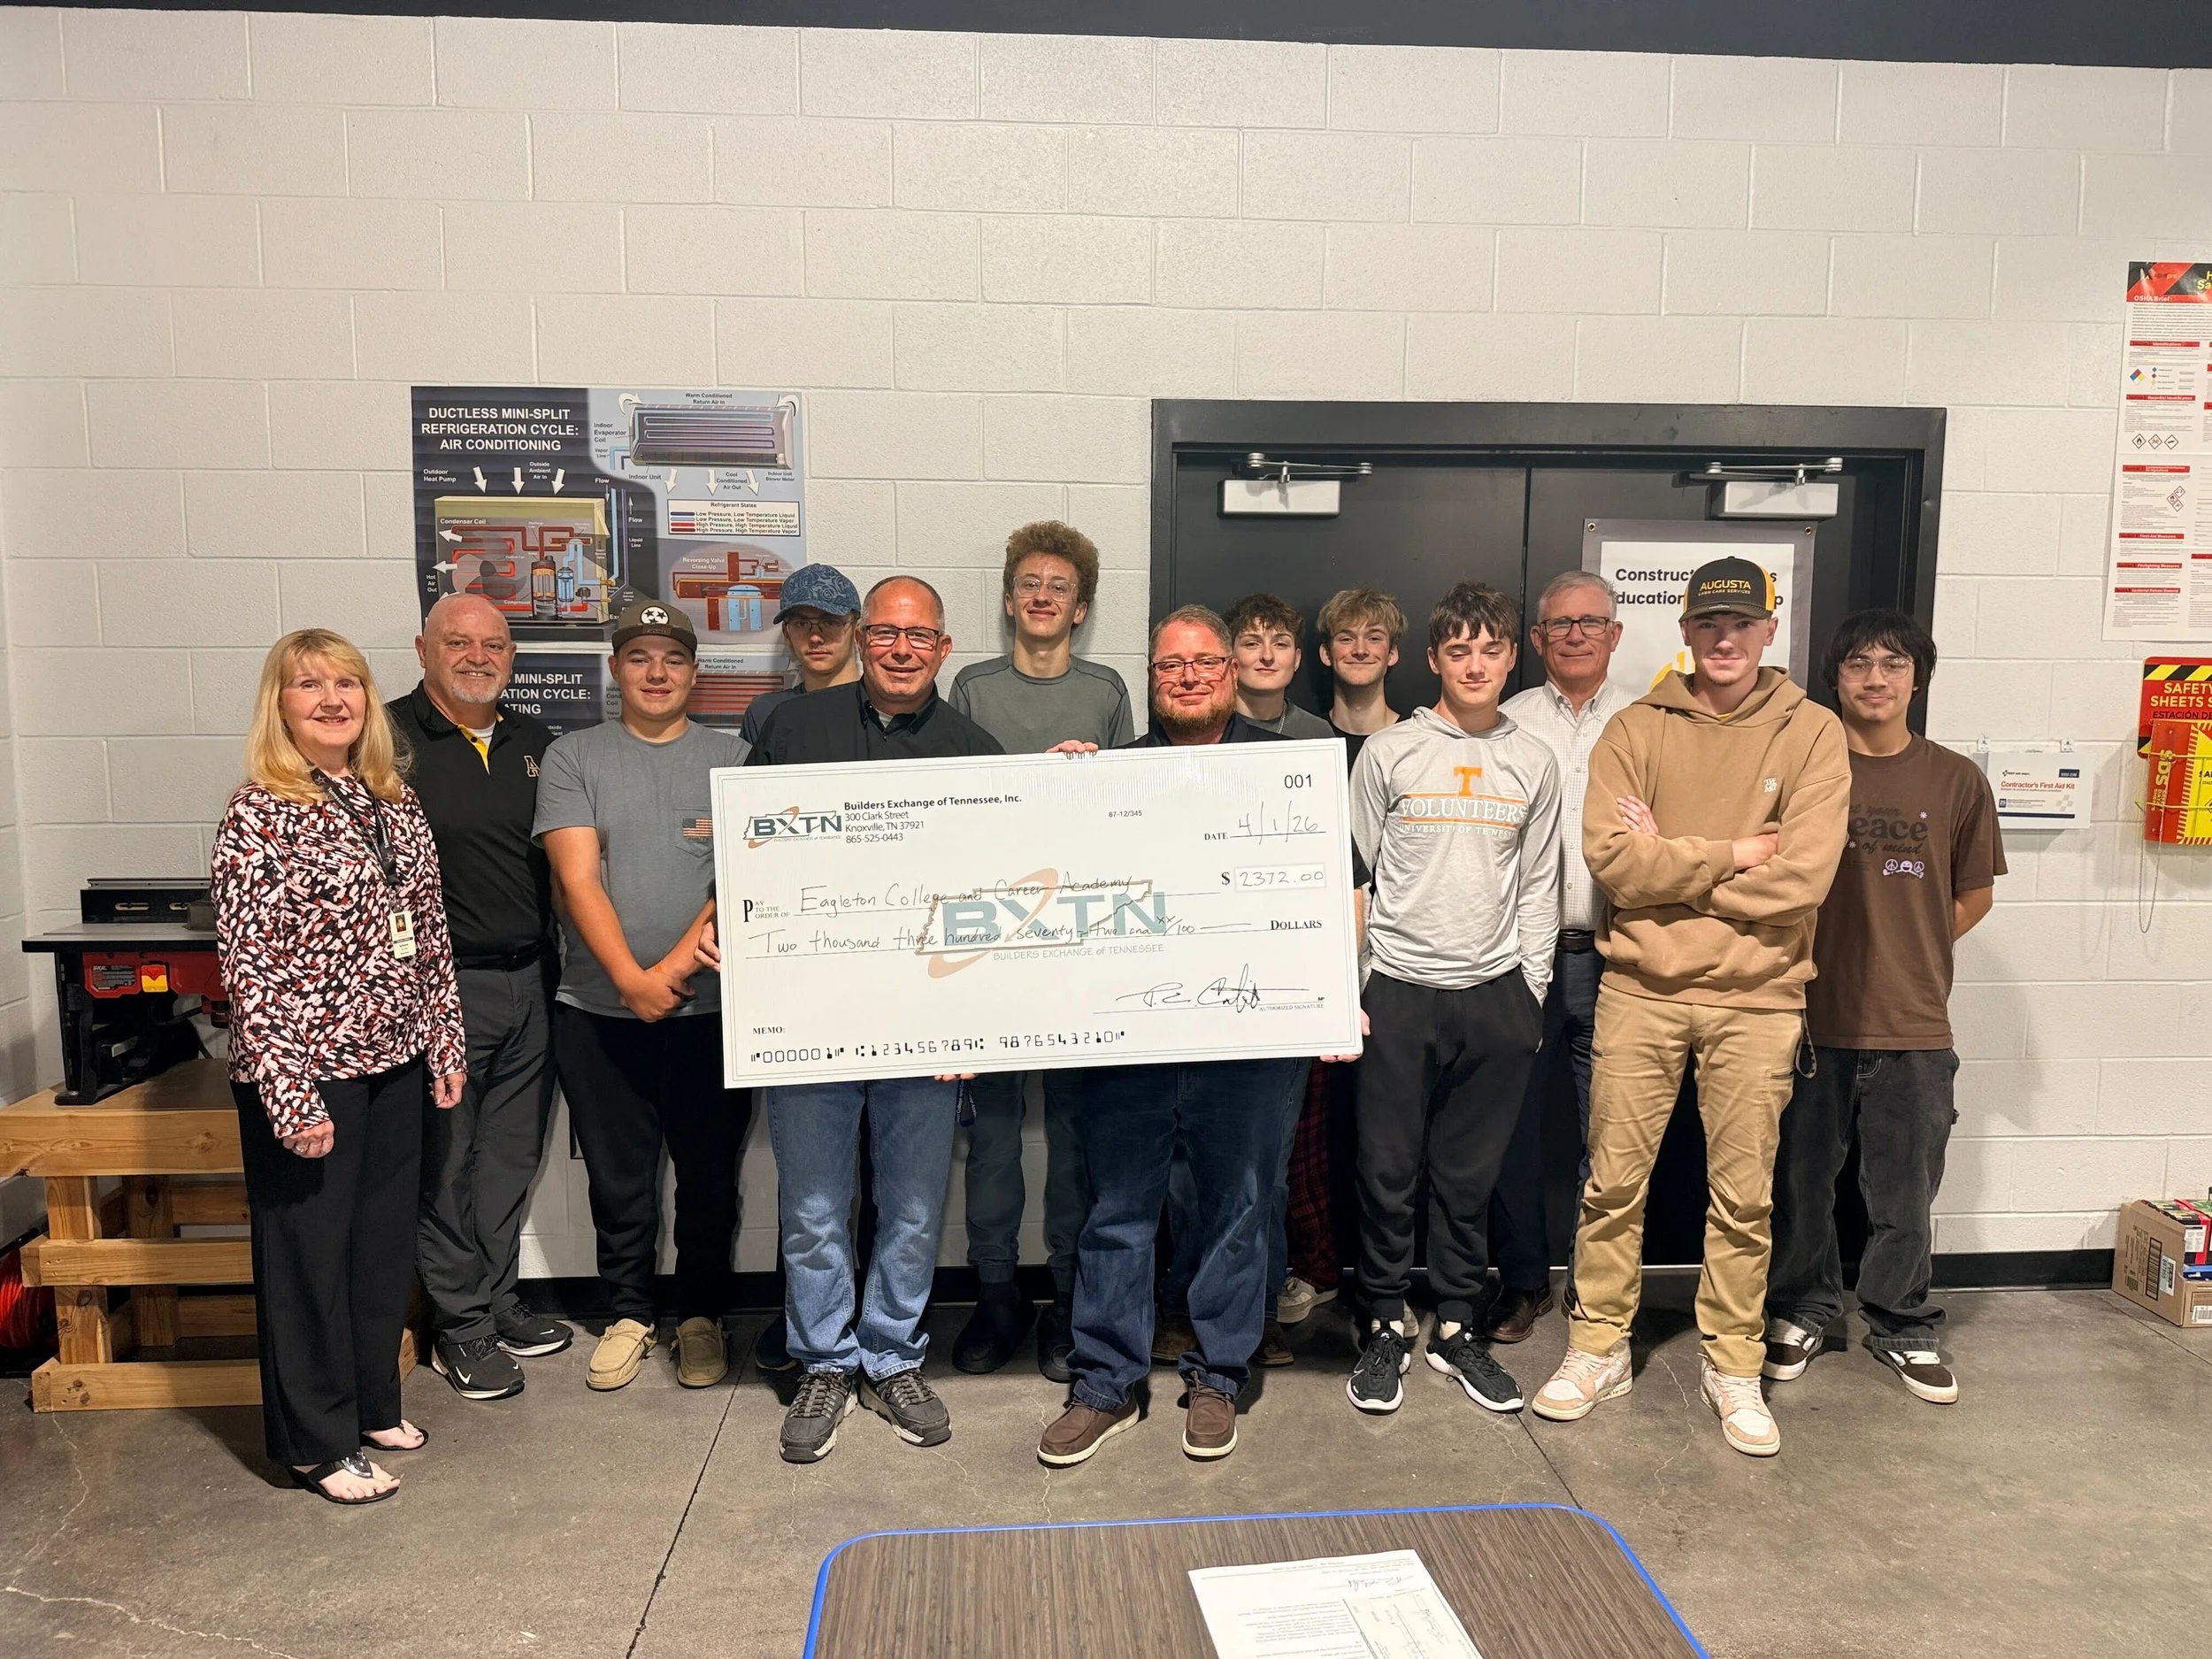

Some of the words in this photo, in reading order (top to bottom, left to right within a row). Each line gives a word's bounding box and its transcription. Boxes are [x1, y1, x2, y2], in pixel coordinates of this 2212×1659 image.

[429, 408, 498, 419] DUCTLESS
[502, 408, 570, 419] MINI-SPLIT
[421, 423, 526, 435] REFRIGERATION
[531, 424, 579, 435] CYCLE:
[440, 439, 462, 450] AIR
[466, 439, 561, 451] CONDITIONING
[1700, 580, 1751, 591] AUGUSTA
[1617, 591, 1684, 605] ducation
[515, 674, 583, 684] MINI-SPLIT
[543, 689, 591, 699] CYCLE:
[2150, 695, 2204, 707] SHEETS
[2153, 710, 2199, 719] ESTACIÓN
[2155, 749, 2173, 786] SDS
[1284, 774, 1313, 789] 001
[1453, 767, 1482, 797] T
[844, 800, 885, 810] Builders
[887, 798, 935, 809] Exchange
[937, 797, 948, 806] of
[949, 796, 1002, 805] Tennessee,
[845, 813, 860, 821] 300
[862, 811, 883, 820] Clark
[884, 811, 909, 819] Street
[1108, 810, 1143, 818] 87-12/345
[1401, 798, 1528, 823] VOLUNTEERS
[753, 815, 842, 836] BXTN
[846, 823, 885, 832] Knoxville,
[900, 821, 924, 829] 37921
[1238, 800, 1318, 846] 4/1/26
[1849, 817, 1928, 842] eace
[846, 833, 904, 844] 865-525-0443
[1204, 833, 1228, 841] DATE
[1862, 839, 1879, 854] of
[1882, 843, 1923, 854] mind
[1221, 872, 1231, 885] $
[1239, 871, 1324, 887] 2372.00
[800, 885, 876, 918] Eagleton
[885, 883, 948, 909] College
[958, 889, 982, 902] and
[994, 880, 1048, 900] Career
[1060, 872, 1132, 895] Academy
[942, 892, 1166, 946] BXTN
[748, 929, 797, 954] Two
[809, 929, 880, 950] thousand
[893, 927, 938, 947] three
[945, 926, 1001, 945] hundred
[994, 950, 1039, 960] BUILDERS
[1043, 948, 1092, 958] EXCHANGE
[1109, 944, 1164, 954] TENNESSEE
